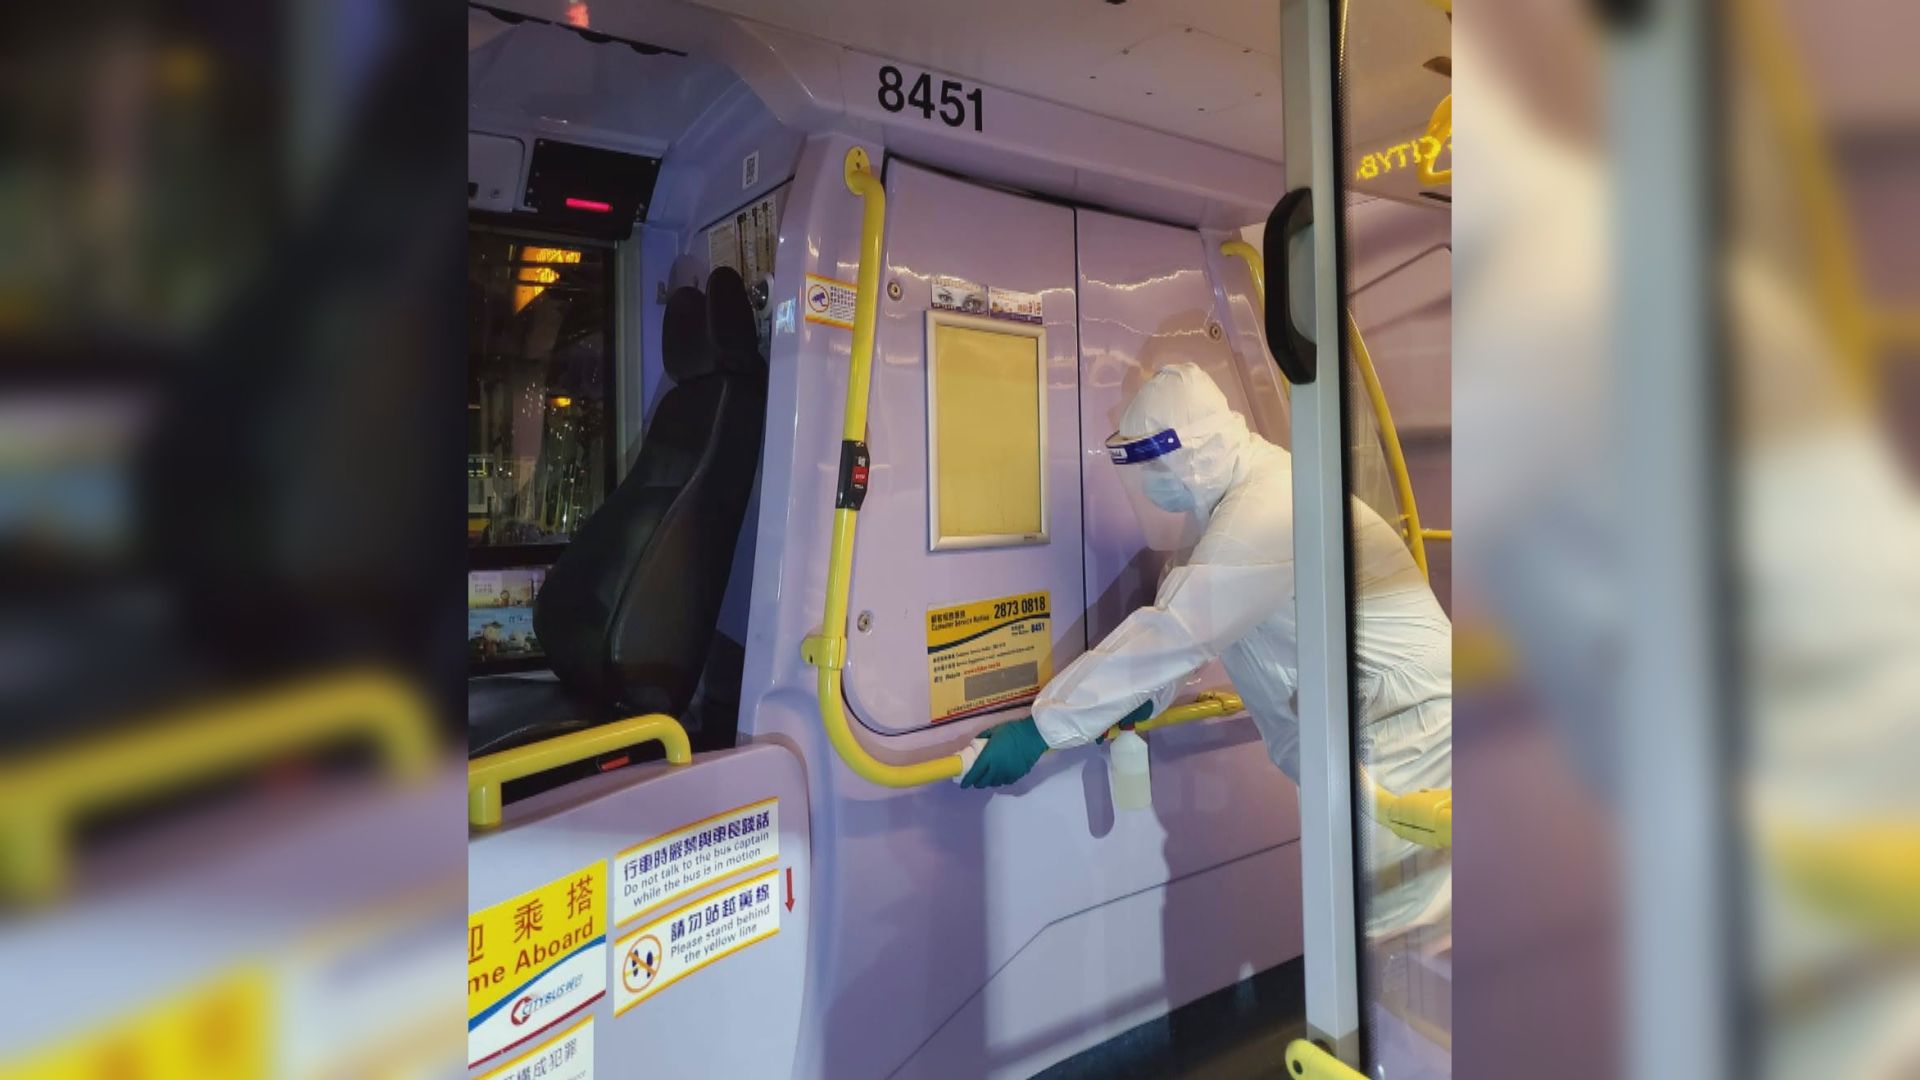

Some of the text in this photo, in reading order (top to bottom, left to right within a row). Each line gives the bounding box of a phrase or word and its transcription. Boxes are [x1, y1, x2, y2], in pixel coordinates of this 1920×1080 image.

[878, 66, 983, 133] 8451
[994, 597, 1046, 619] 2873 0818
[624, 832, 769, 897] Do not talk to the bus captain
[633, 848, 761, 907] while the bus is in motion
[514, 916, 594, 975] Aboard
[671, 904, 770, 958] Please stand behind
[684, 924, 757, 963] the yellow line
